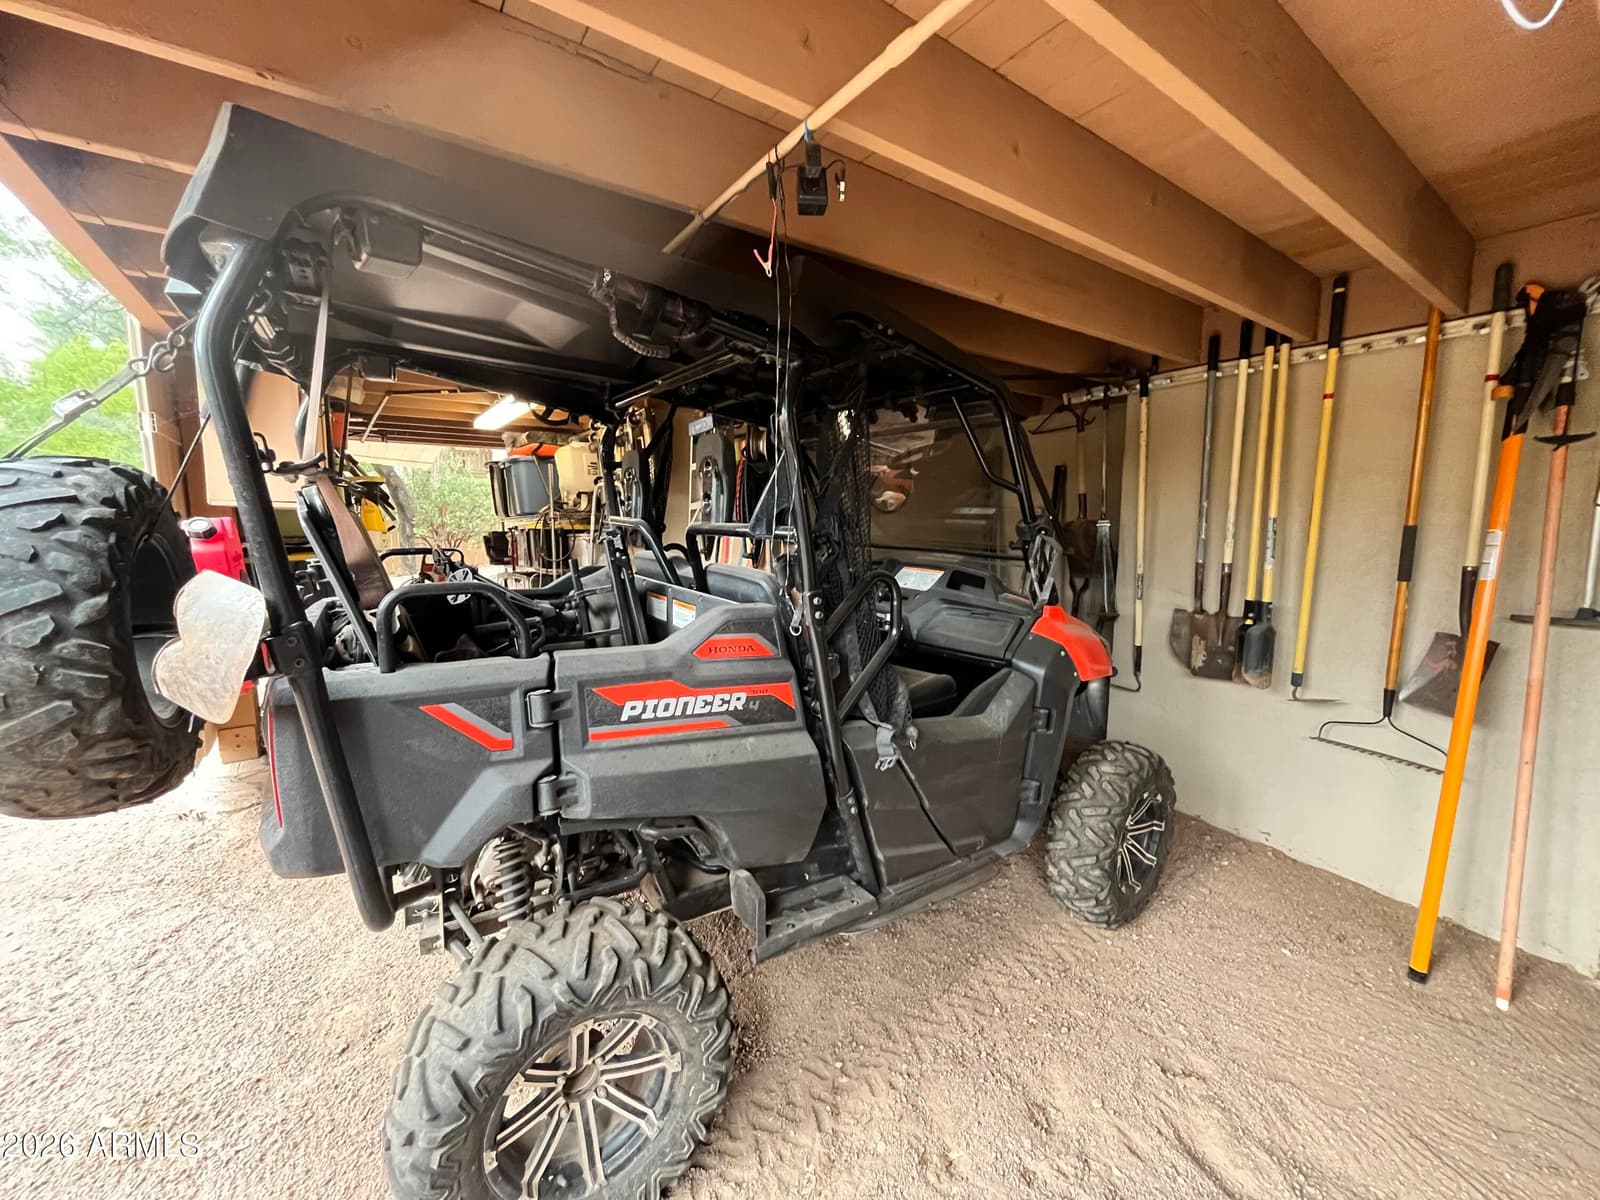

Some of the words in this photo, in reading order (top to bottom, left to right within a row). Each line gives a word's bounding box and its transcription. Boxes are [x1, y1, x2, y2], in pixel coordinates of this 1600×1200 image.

[708, 645, 756, 654] HONDA
[620, 691, 748, 722] PIONEER
[748, 700, 760, 711] 4
